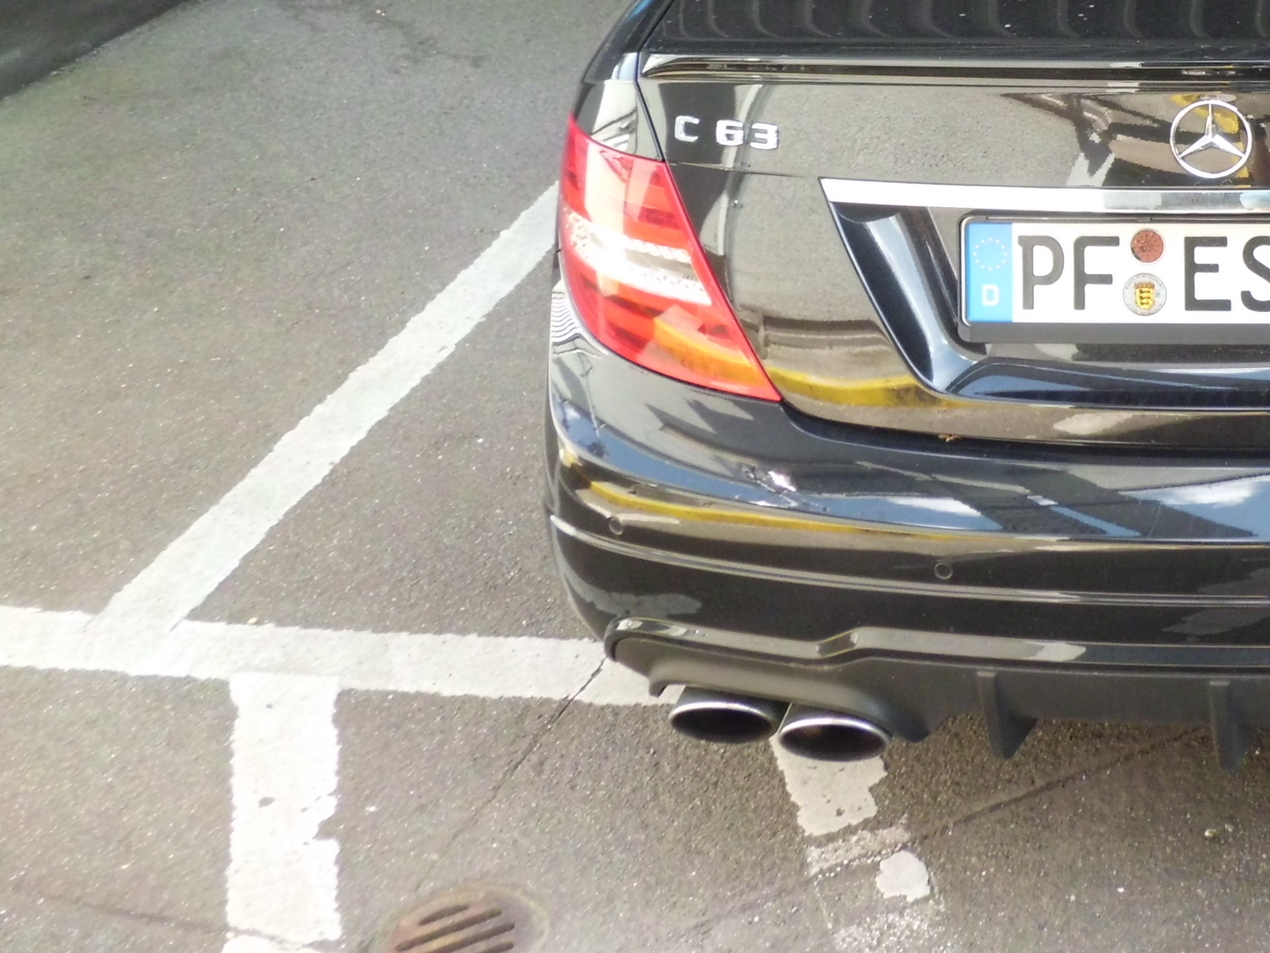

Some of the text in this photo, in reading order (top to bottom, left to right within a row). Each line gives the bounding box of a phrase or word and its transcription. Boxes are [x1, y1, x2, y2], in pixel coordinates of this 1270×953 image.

[674, 115, 779, 150] C 63
[1018, 235, 1120, 311] PF
[981, 284, 999, 307] D
